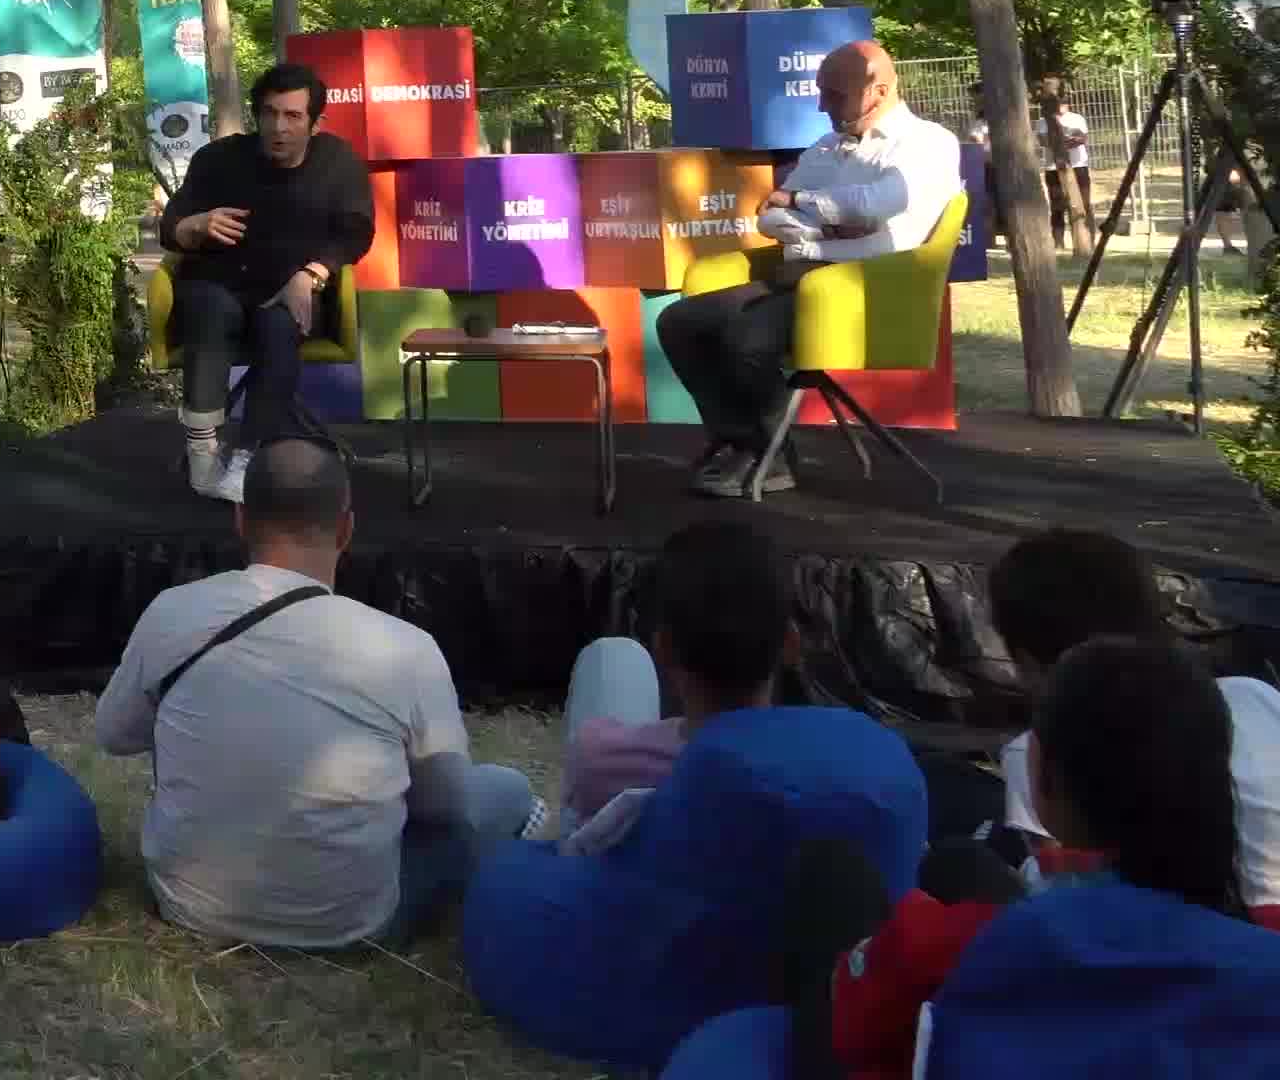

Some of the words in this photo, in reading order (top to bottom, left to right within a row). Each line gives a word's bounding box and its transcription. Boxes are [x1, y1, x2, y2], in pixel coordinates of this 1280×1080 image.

[687, 53, 729, 74] DÜNYA
[326, 83, 364, 104] KRASİ
[370, 79, 471, 103] DEMOKRASİ
[690, 79, 729, 99] KENTİ
[414, 196, 441, 217] KRİZ
[503, 195, 545, 217] KRİZ
[600, 192, 633, 216] EŞİT
[699, 188, 737, 214] EŞİT
[400, 219, 458, 242] YÖNETİMİ
[482, 217, 569, 241] YÖNETİMİ
[585, 221, 662, 241] URTTAŞLIK
